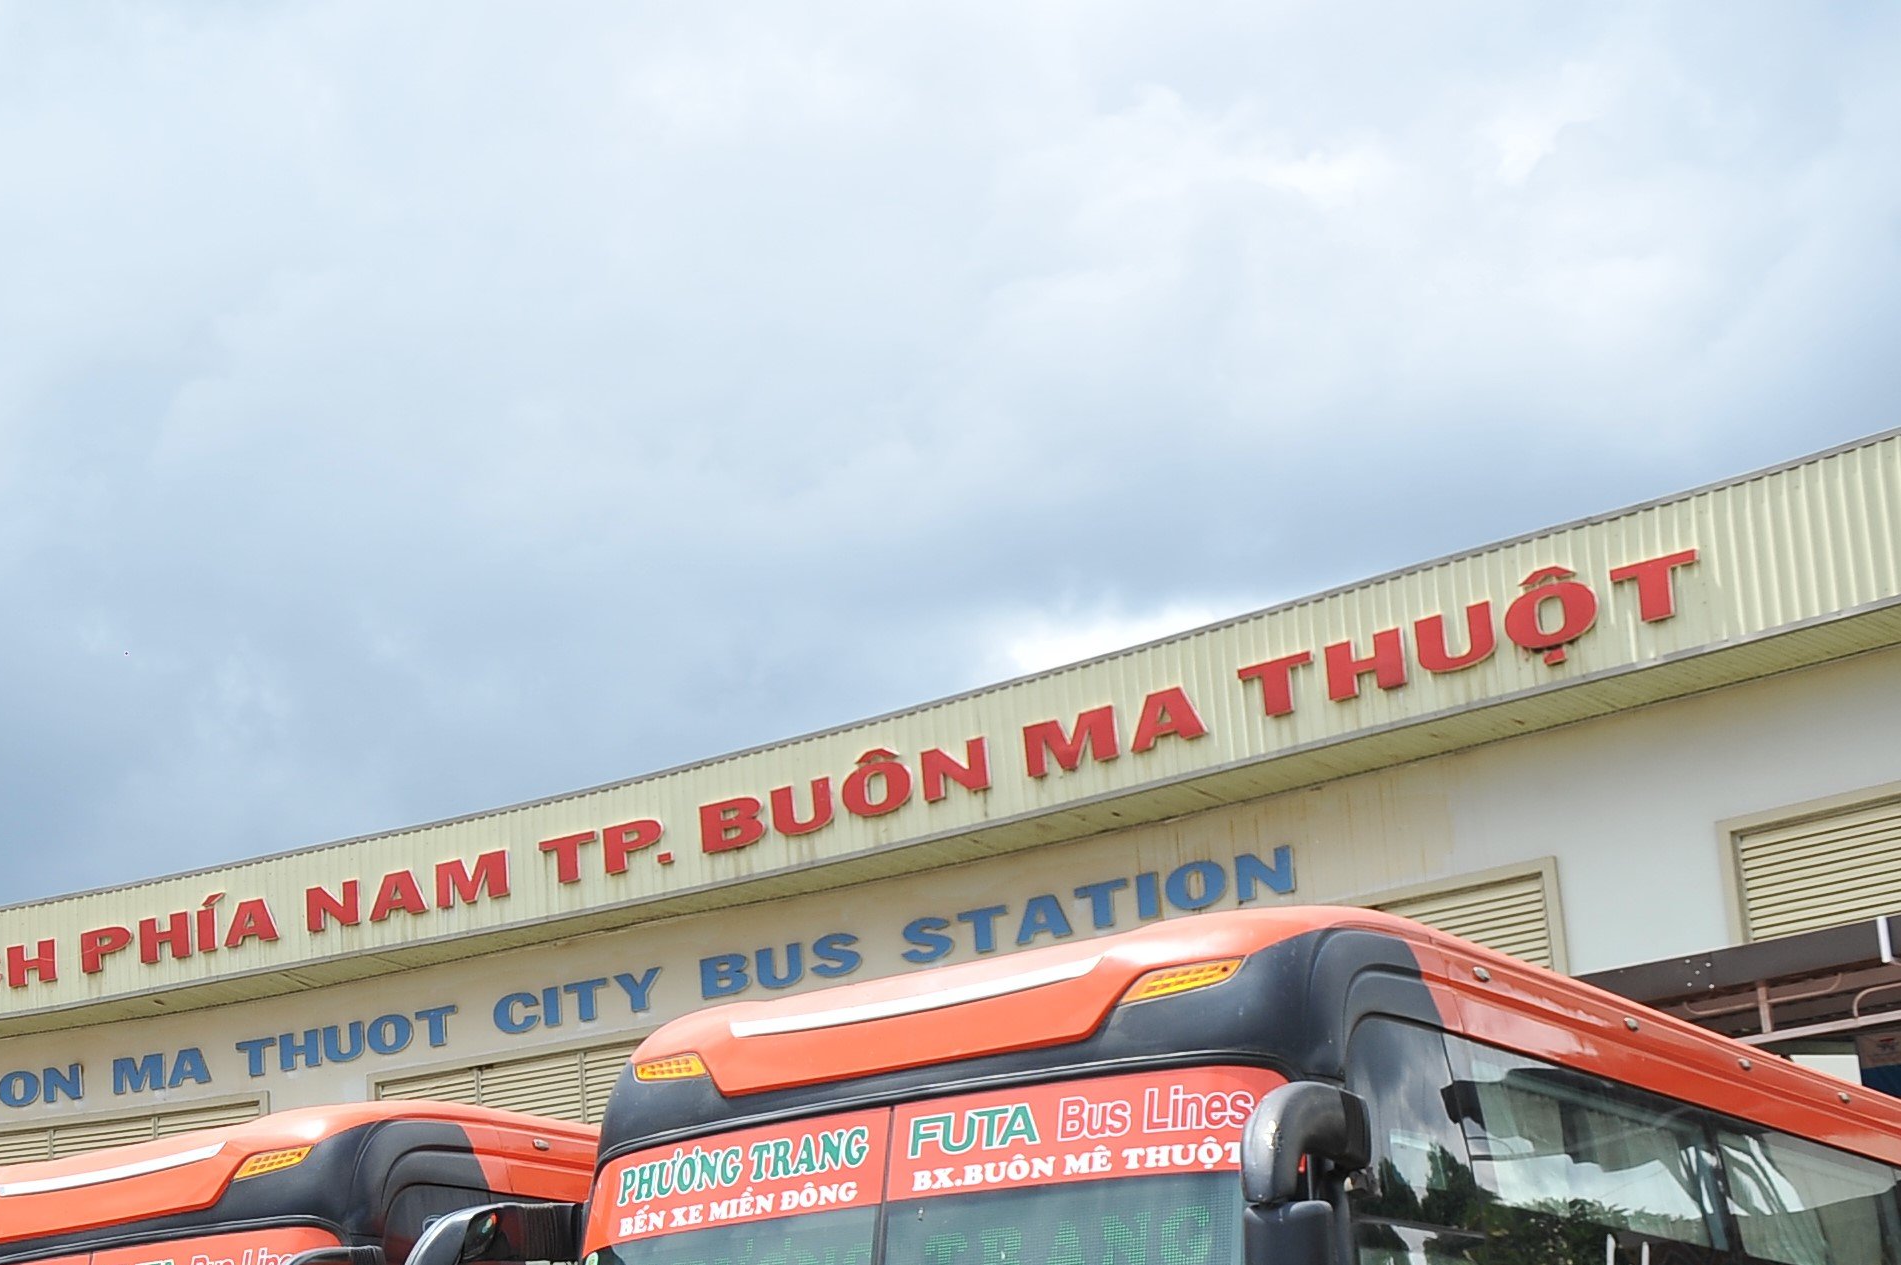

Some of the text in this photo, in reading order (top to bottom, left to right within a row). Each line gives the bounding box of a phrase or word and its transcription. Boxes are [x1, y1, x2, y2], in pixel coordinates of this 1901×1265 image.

[81, 892, 279, 974] PHÍA
[306, 849, 511, 932] NAM
[539, 819, 673, 882] TP.
[700, 737, 991, 854] BUÔN
[1023, 685, 1209, 778] MA
[1237, 549, 1698, 717] THUỘT
[113, 1047, 211, 1096] MA
[237, 1004, 457, 1077] THUOT
[494, 966, 661, 1035] CITY
[702, 932, 862, 999] BUS
[901, 845, 1295, 964] STATION
[907, 1085, 1254, 1159] FUTA Bus Lines
[617, 1126, 869, 1206] PHƯƠNG TRANG
[912, 1154, 1056, 1191] BX.BUÔN
[1063, 1145, 1112, 1176] MÊ
[619, 1181, 858, 1237] BẾN XE MIỀN ĐÔNG
